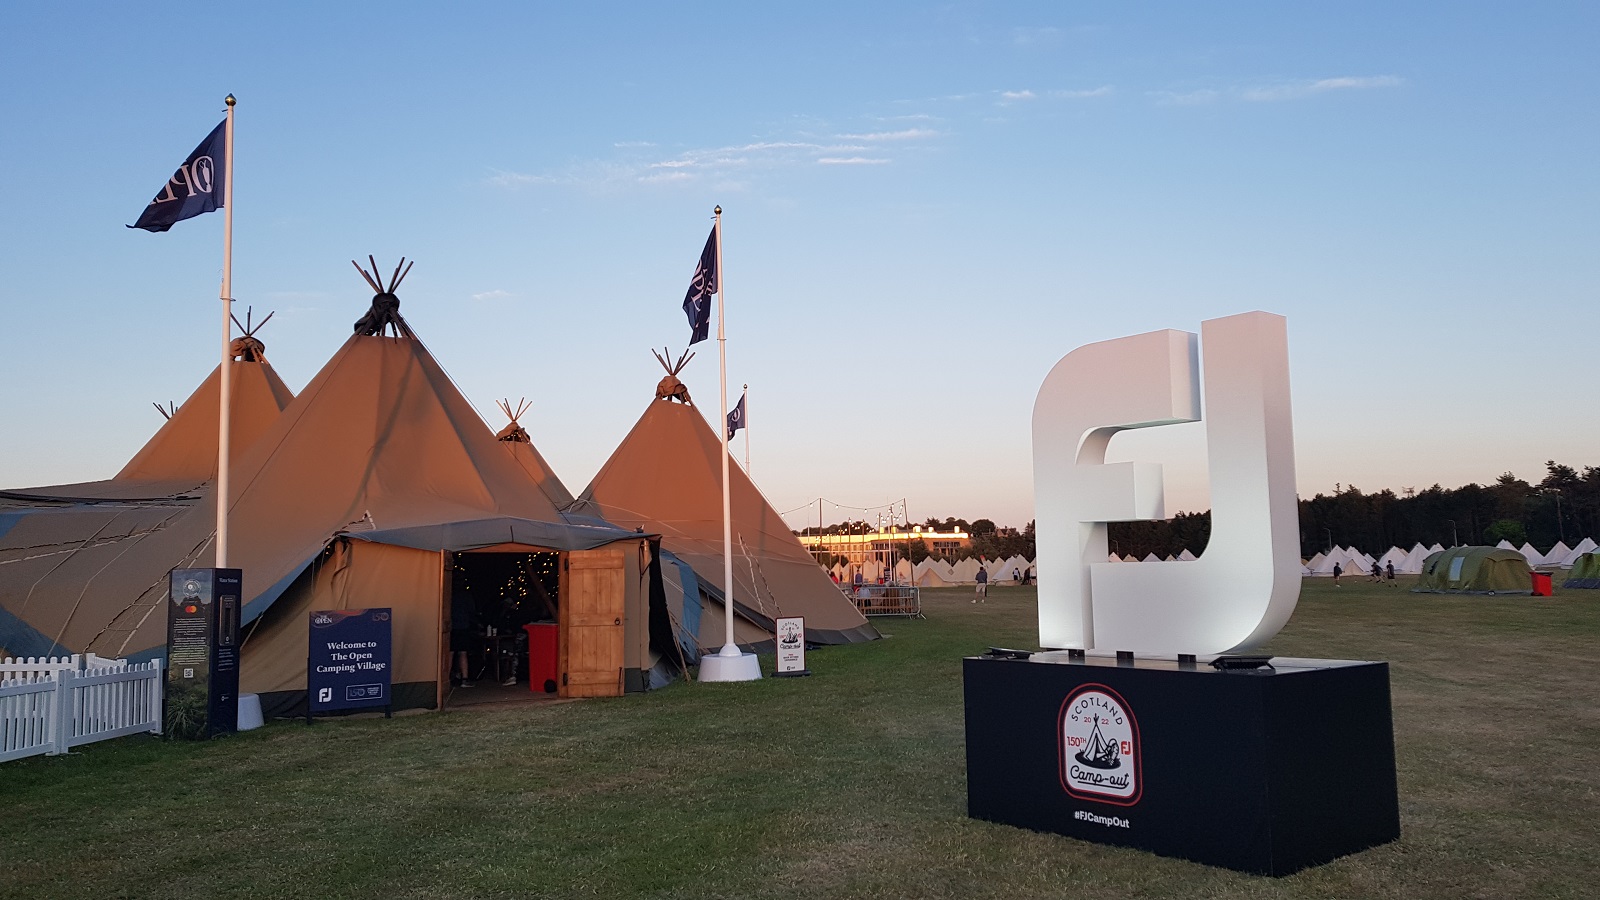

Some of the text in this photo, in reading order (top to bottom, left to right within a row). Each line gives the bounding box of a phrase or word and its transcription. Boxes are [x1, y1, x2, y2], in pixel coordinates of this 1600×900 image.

[1032, 310, 1301, 655] FJ
[327, 641, 366, 650] Welcome
[331, 652, 372, 661] The Open
[316, 661, 386, 674] Camping Village
[319, 687, 332, 702] FJ
[1071, 697, 1123, 725] SCOTLAND
[1067, 736, 1087, 747] 150TH
[1121, 741, 1131, 755] FJ
[1070, 765, 1129, 787] Camp-out
[1074, 811, 1130, 829] #FJCampOut
